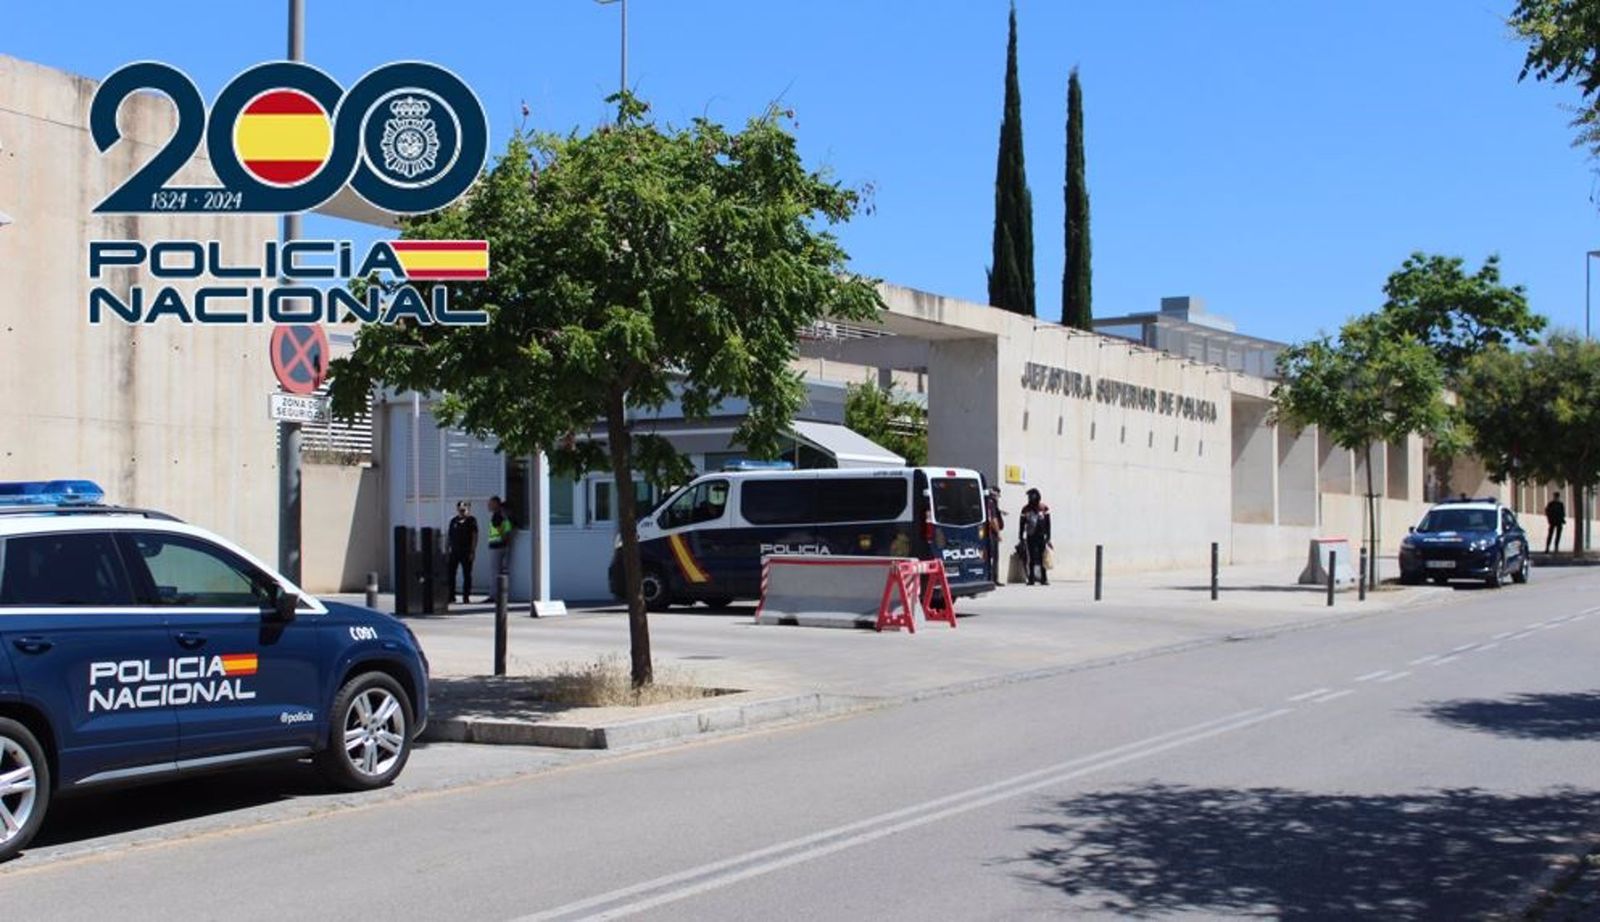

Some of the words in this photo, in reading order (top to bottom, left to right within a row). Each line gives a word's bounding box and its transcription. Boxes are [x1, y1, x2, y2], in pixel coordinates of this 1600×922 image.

[282, 397, 306, 407] ZONA
[1021, 361, 1092, 401] JEFATURA
[1096, 378, 1157, 413] SUPERIOR
[1158, 390, 1174, 416] DE
[88, 678, 256, 712] NACIONAL
